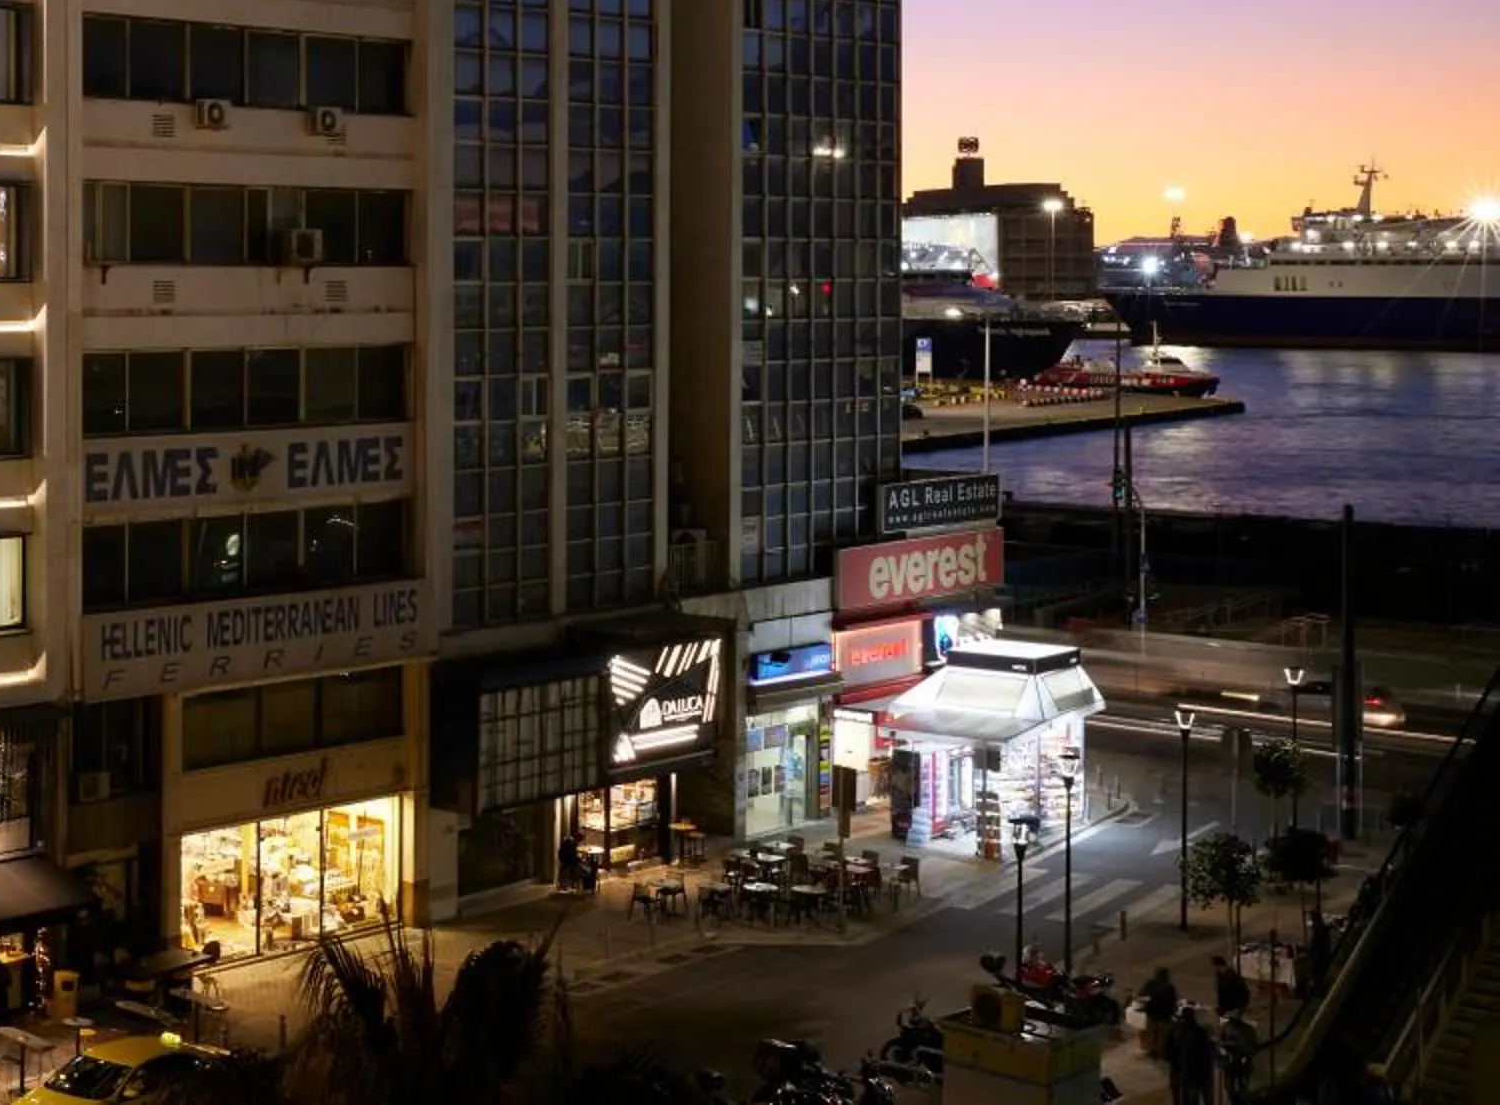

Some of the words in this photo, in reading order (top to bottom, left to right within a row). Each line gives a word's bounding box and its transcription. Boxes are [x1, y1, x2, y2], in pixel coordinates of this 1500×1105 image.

[888, 487, 921, 510] AGL
[925, 483, 953, 504] Real
[957, 481, 997, 501] Estate
[868, 533, 989, 598] everest
[100, 615, 193, 661] HELLENIC
[206, 597, 360, 650] MEDITERRANEAN
[373, 589, 418, 627] LINES
